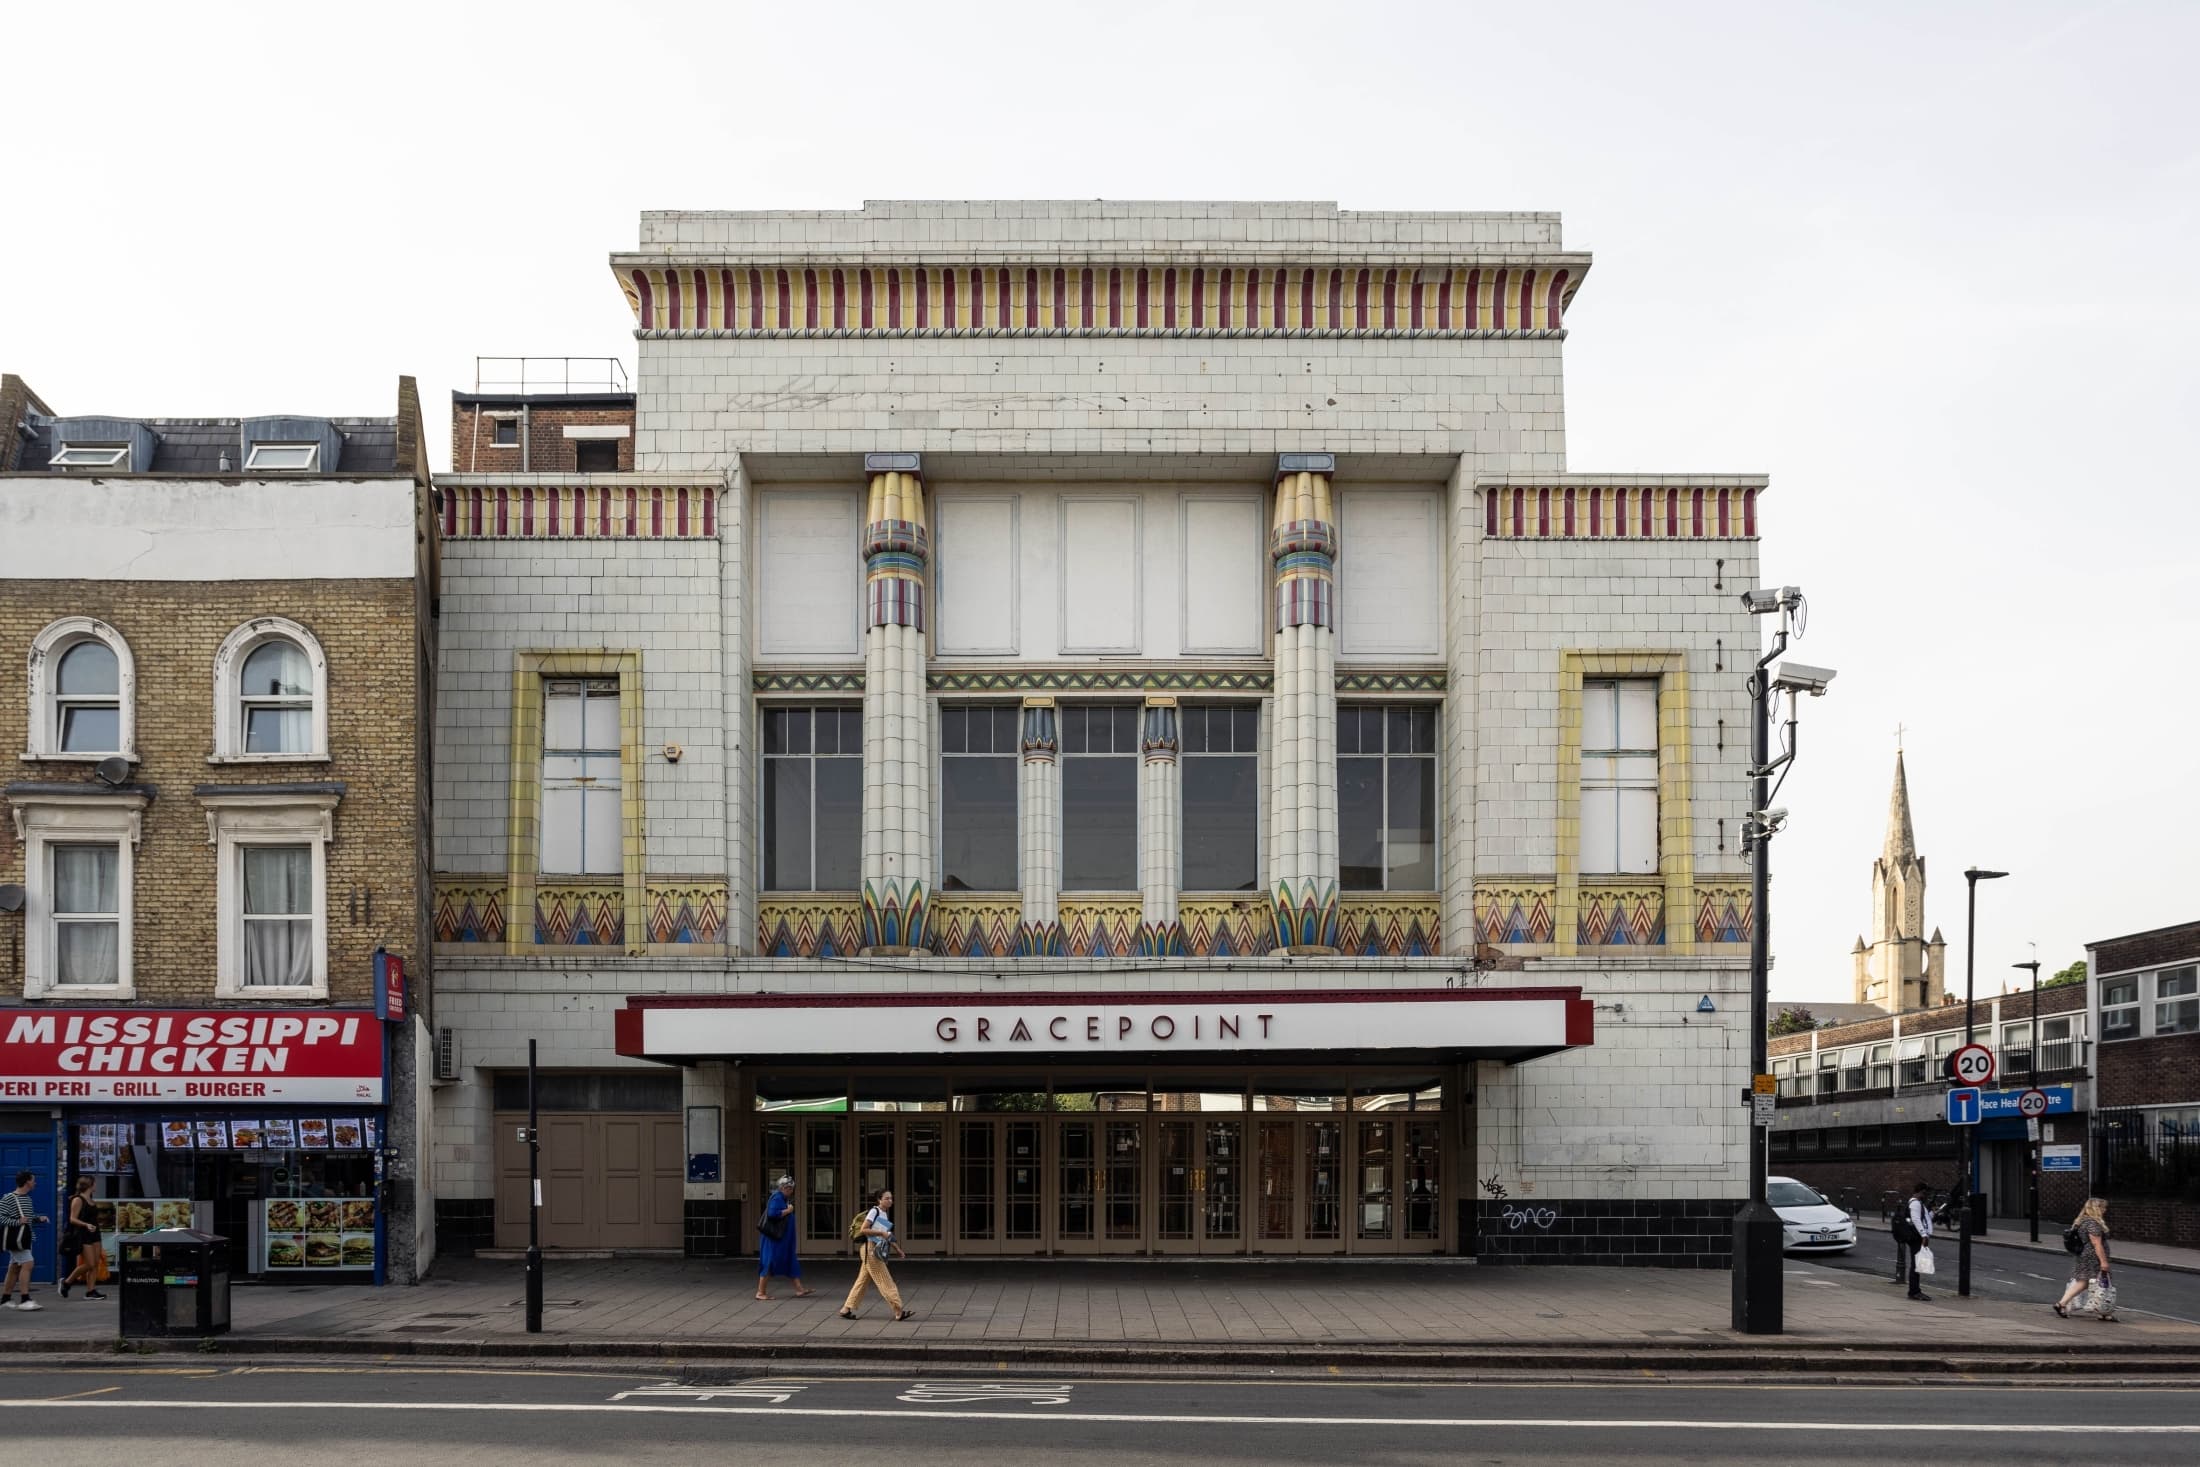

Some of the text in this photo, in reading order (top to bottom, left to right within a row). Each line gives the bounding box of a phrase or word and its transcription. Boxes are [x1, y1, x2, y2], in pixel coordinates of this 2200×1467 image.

[936, 1015, 1273, 1041] GRACEPOINT
[58, 1046, 289, 1071] CHICKEN
[1961, 1056, 1989, 1073] 20
[0, 1082, 37, 1096] ERI
[45, 1082, 90, 1096] PERI
[113, 1082, 161, 1096] GRILL
[186, 1082, 266, 1097] BURGER
[2001, 1097, 2020, 1108] Heal
[2048, 1095, 2062, 1104] tre
[2024, 1098, 2043, 1109] 20
